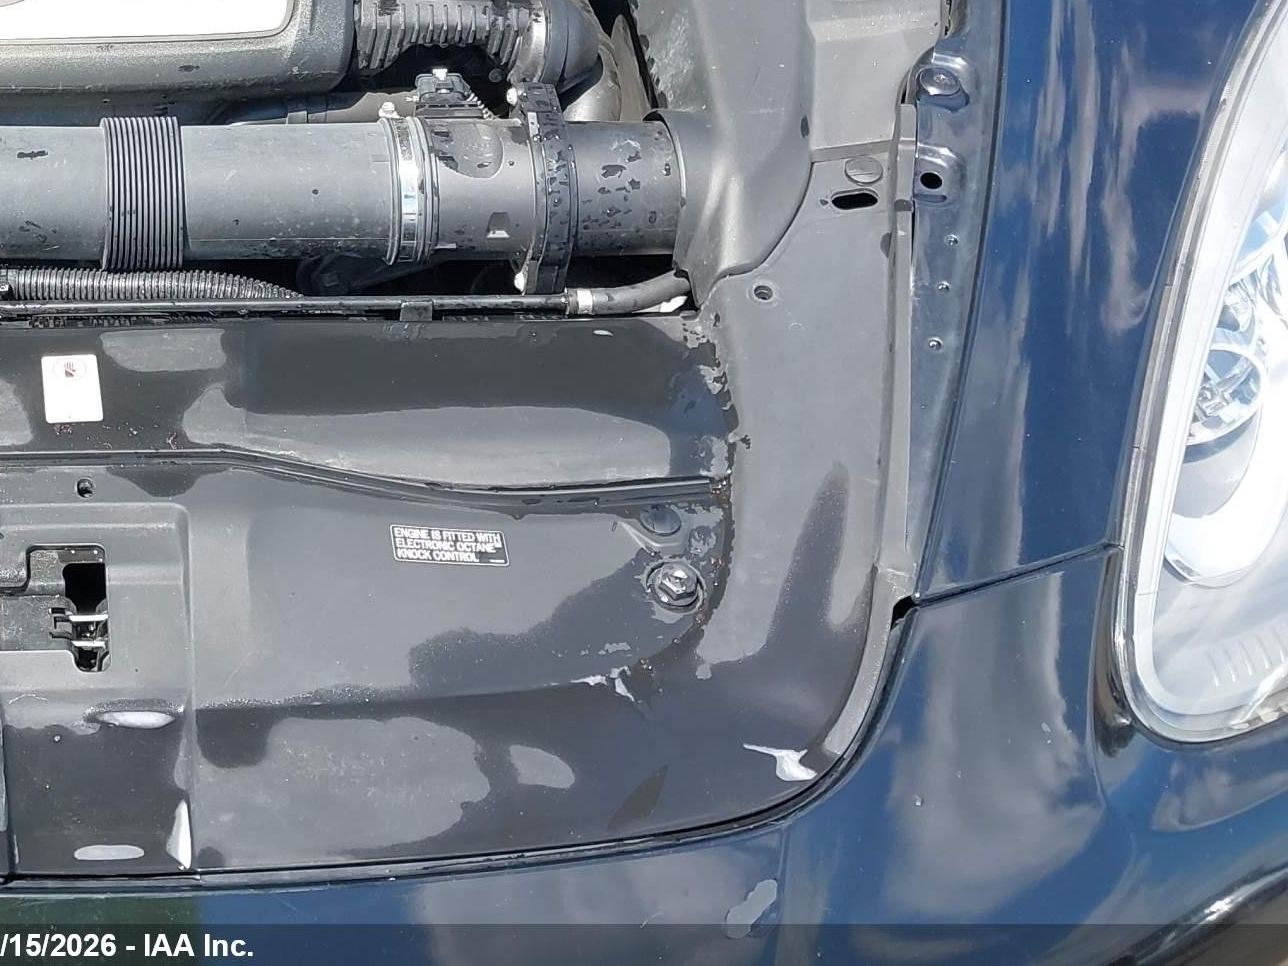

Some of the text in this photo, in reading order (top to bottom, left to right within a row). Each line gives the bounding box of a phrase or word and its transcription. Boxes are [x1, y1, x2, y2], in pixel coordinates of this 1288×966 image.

[394, 528, 500, 544] ENGINE IS FITTED WITH
[396, 539, 456, 550] ELECTRONIC
[457, 542, 496, 553] OCTANE
[397, 549, 432, 560] KNOCK
